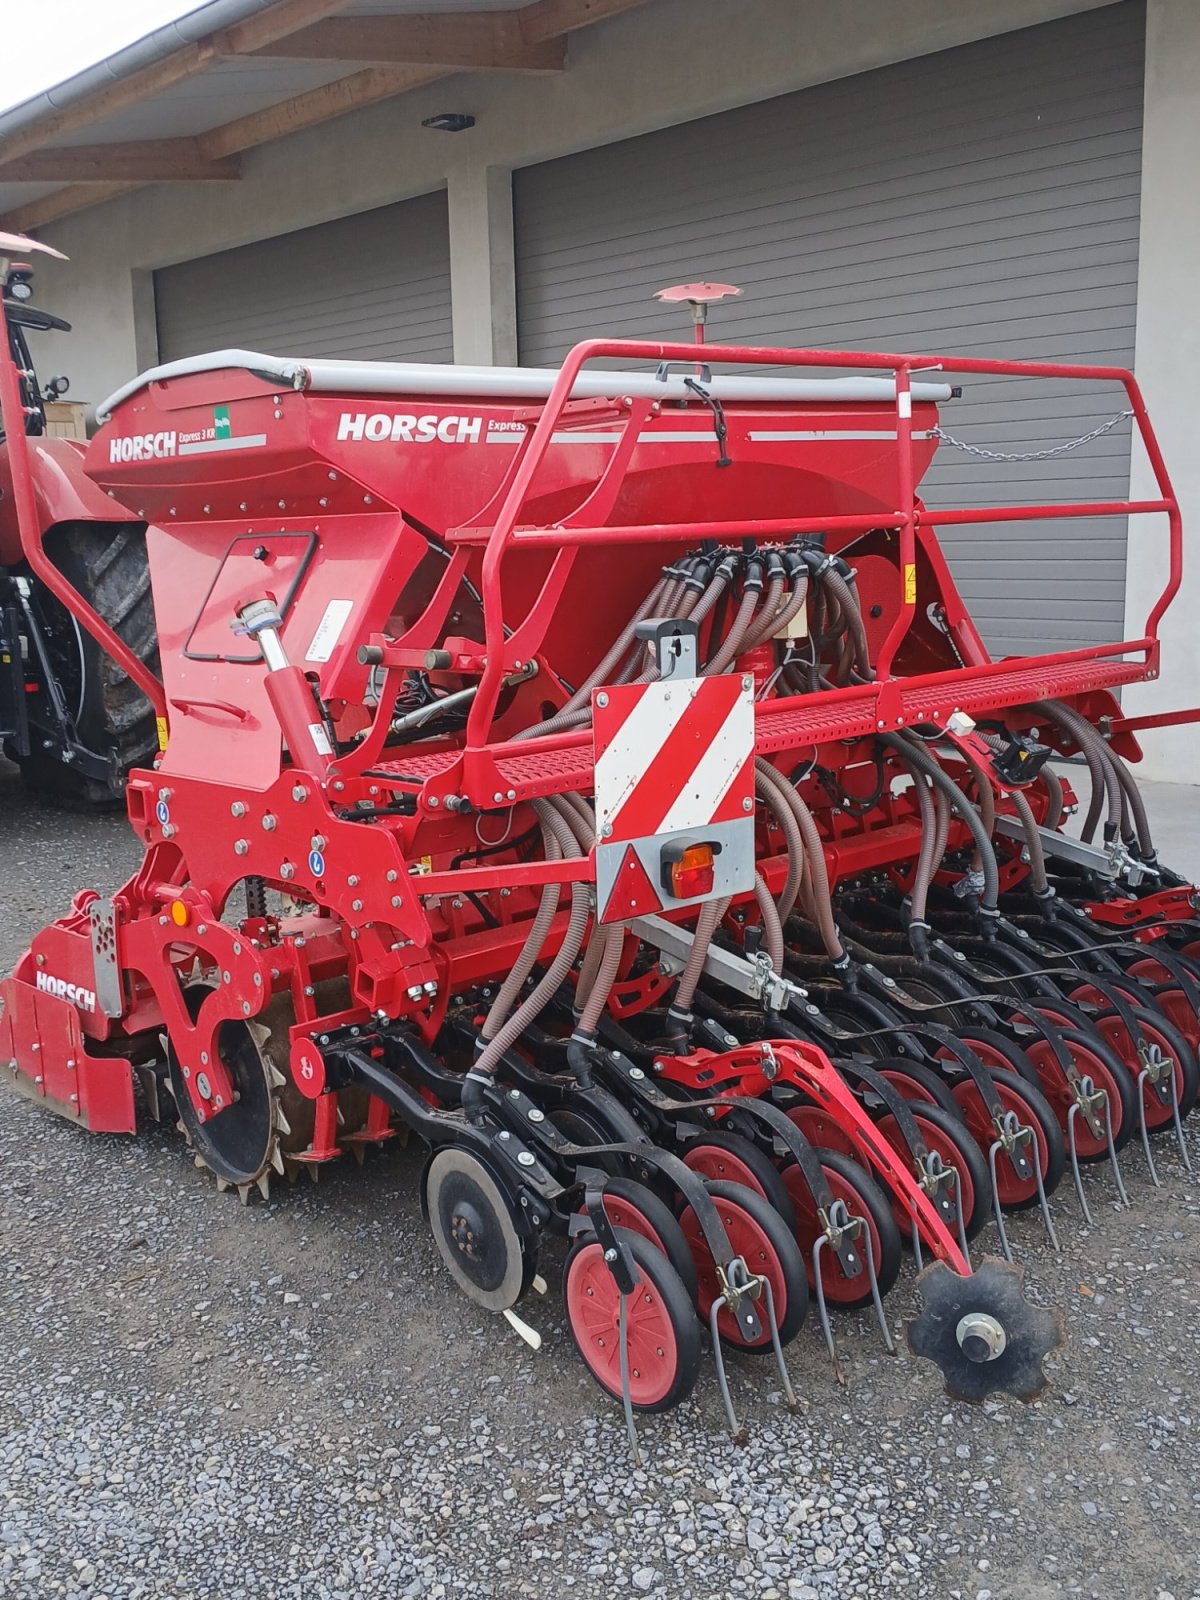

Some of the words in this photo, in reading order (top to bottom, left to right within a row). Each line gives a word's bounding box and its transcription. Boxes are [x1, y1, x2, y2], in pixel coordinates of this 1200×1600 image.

[110, 430, 177, 464] HORSCH
[178, 431, 201, 443] Express
[201, 428, 206, 440] 3
[336, 413, 483, 443] HORSCH
[488, 419, 526, 431] Express
[36, 970, 96, 1014] HORSCH
